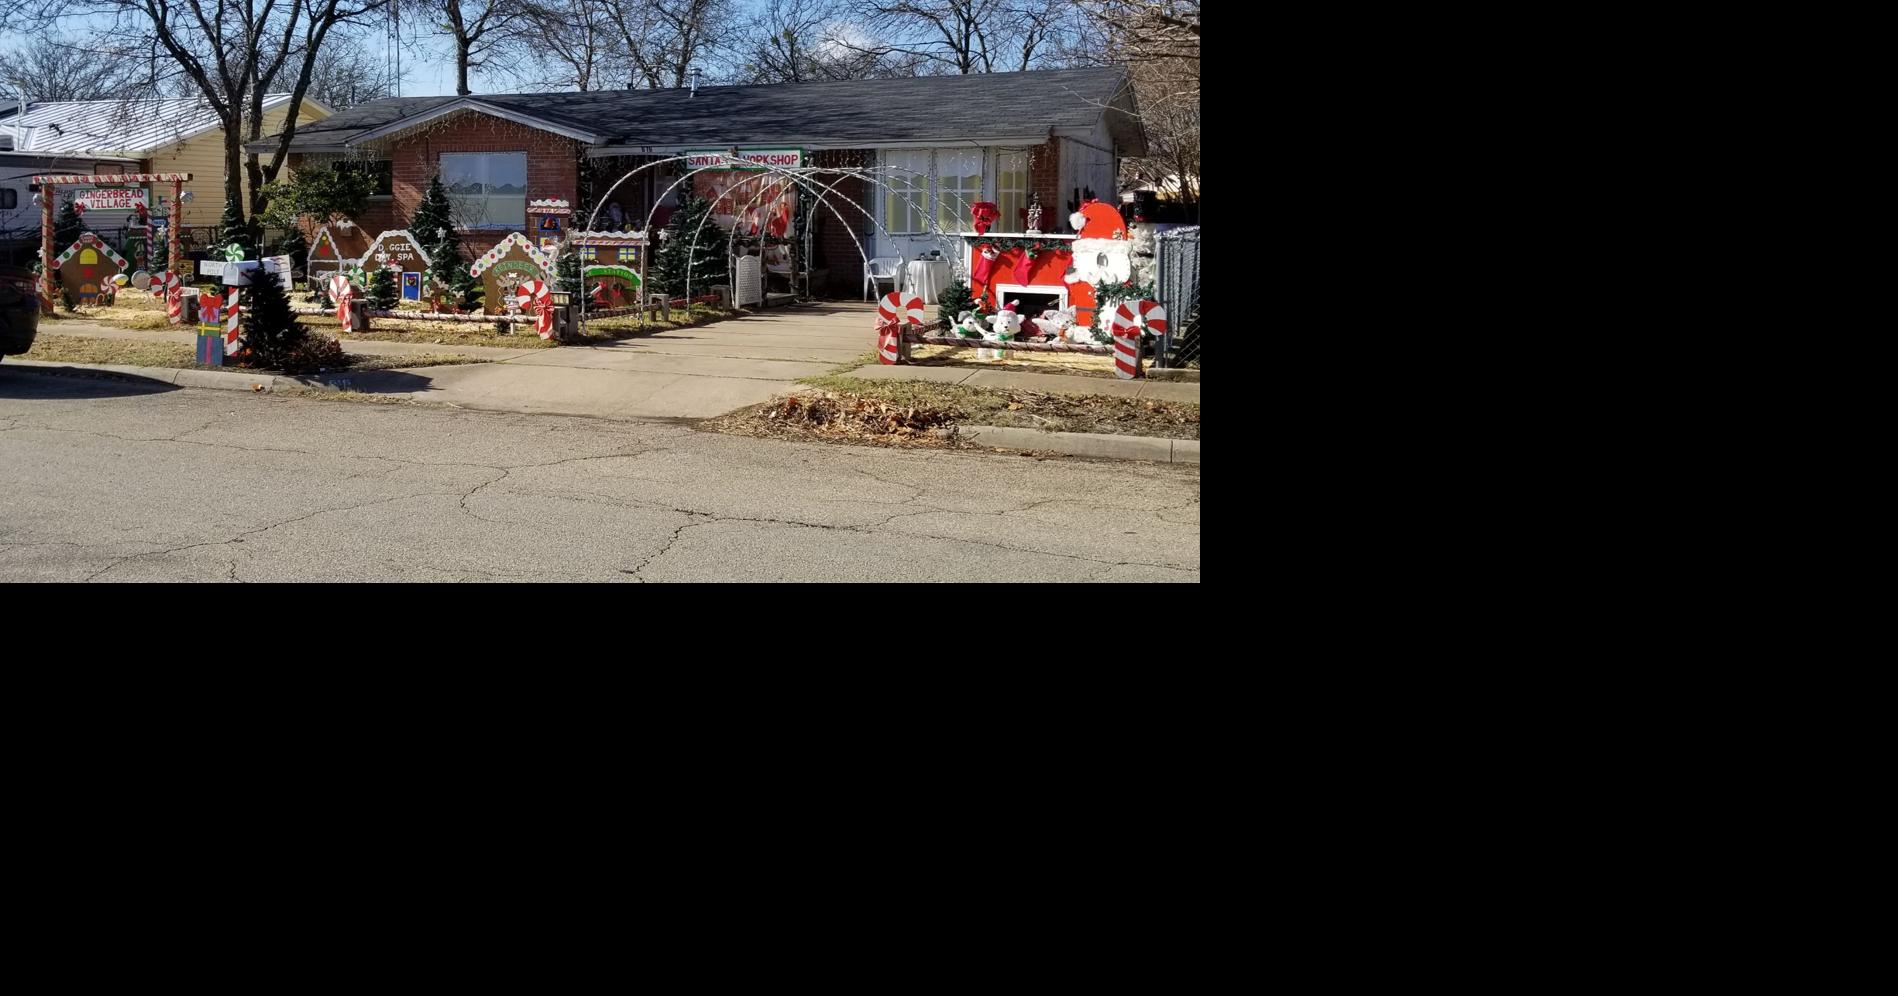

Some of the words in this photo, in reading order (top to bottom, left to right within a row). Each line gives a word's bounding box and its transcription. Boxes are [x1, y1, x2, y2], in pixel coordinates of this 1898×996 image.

[79, 188, 144, 199] GINGERBREAD
[90, 199, 131, 208] VILLAGE
[378, 243, 411, 252] DGGIE
[397, 253, 414, 261] SPA
